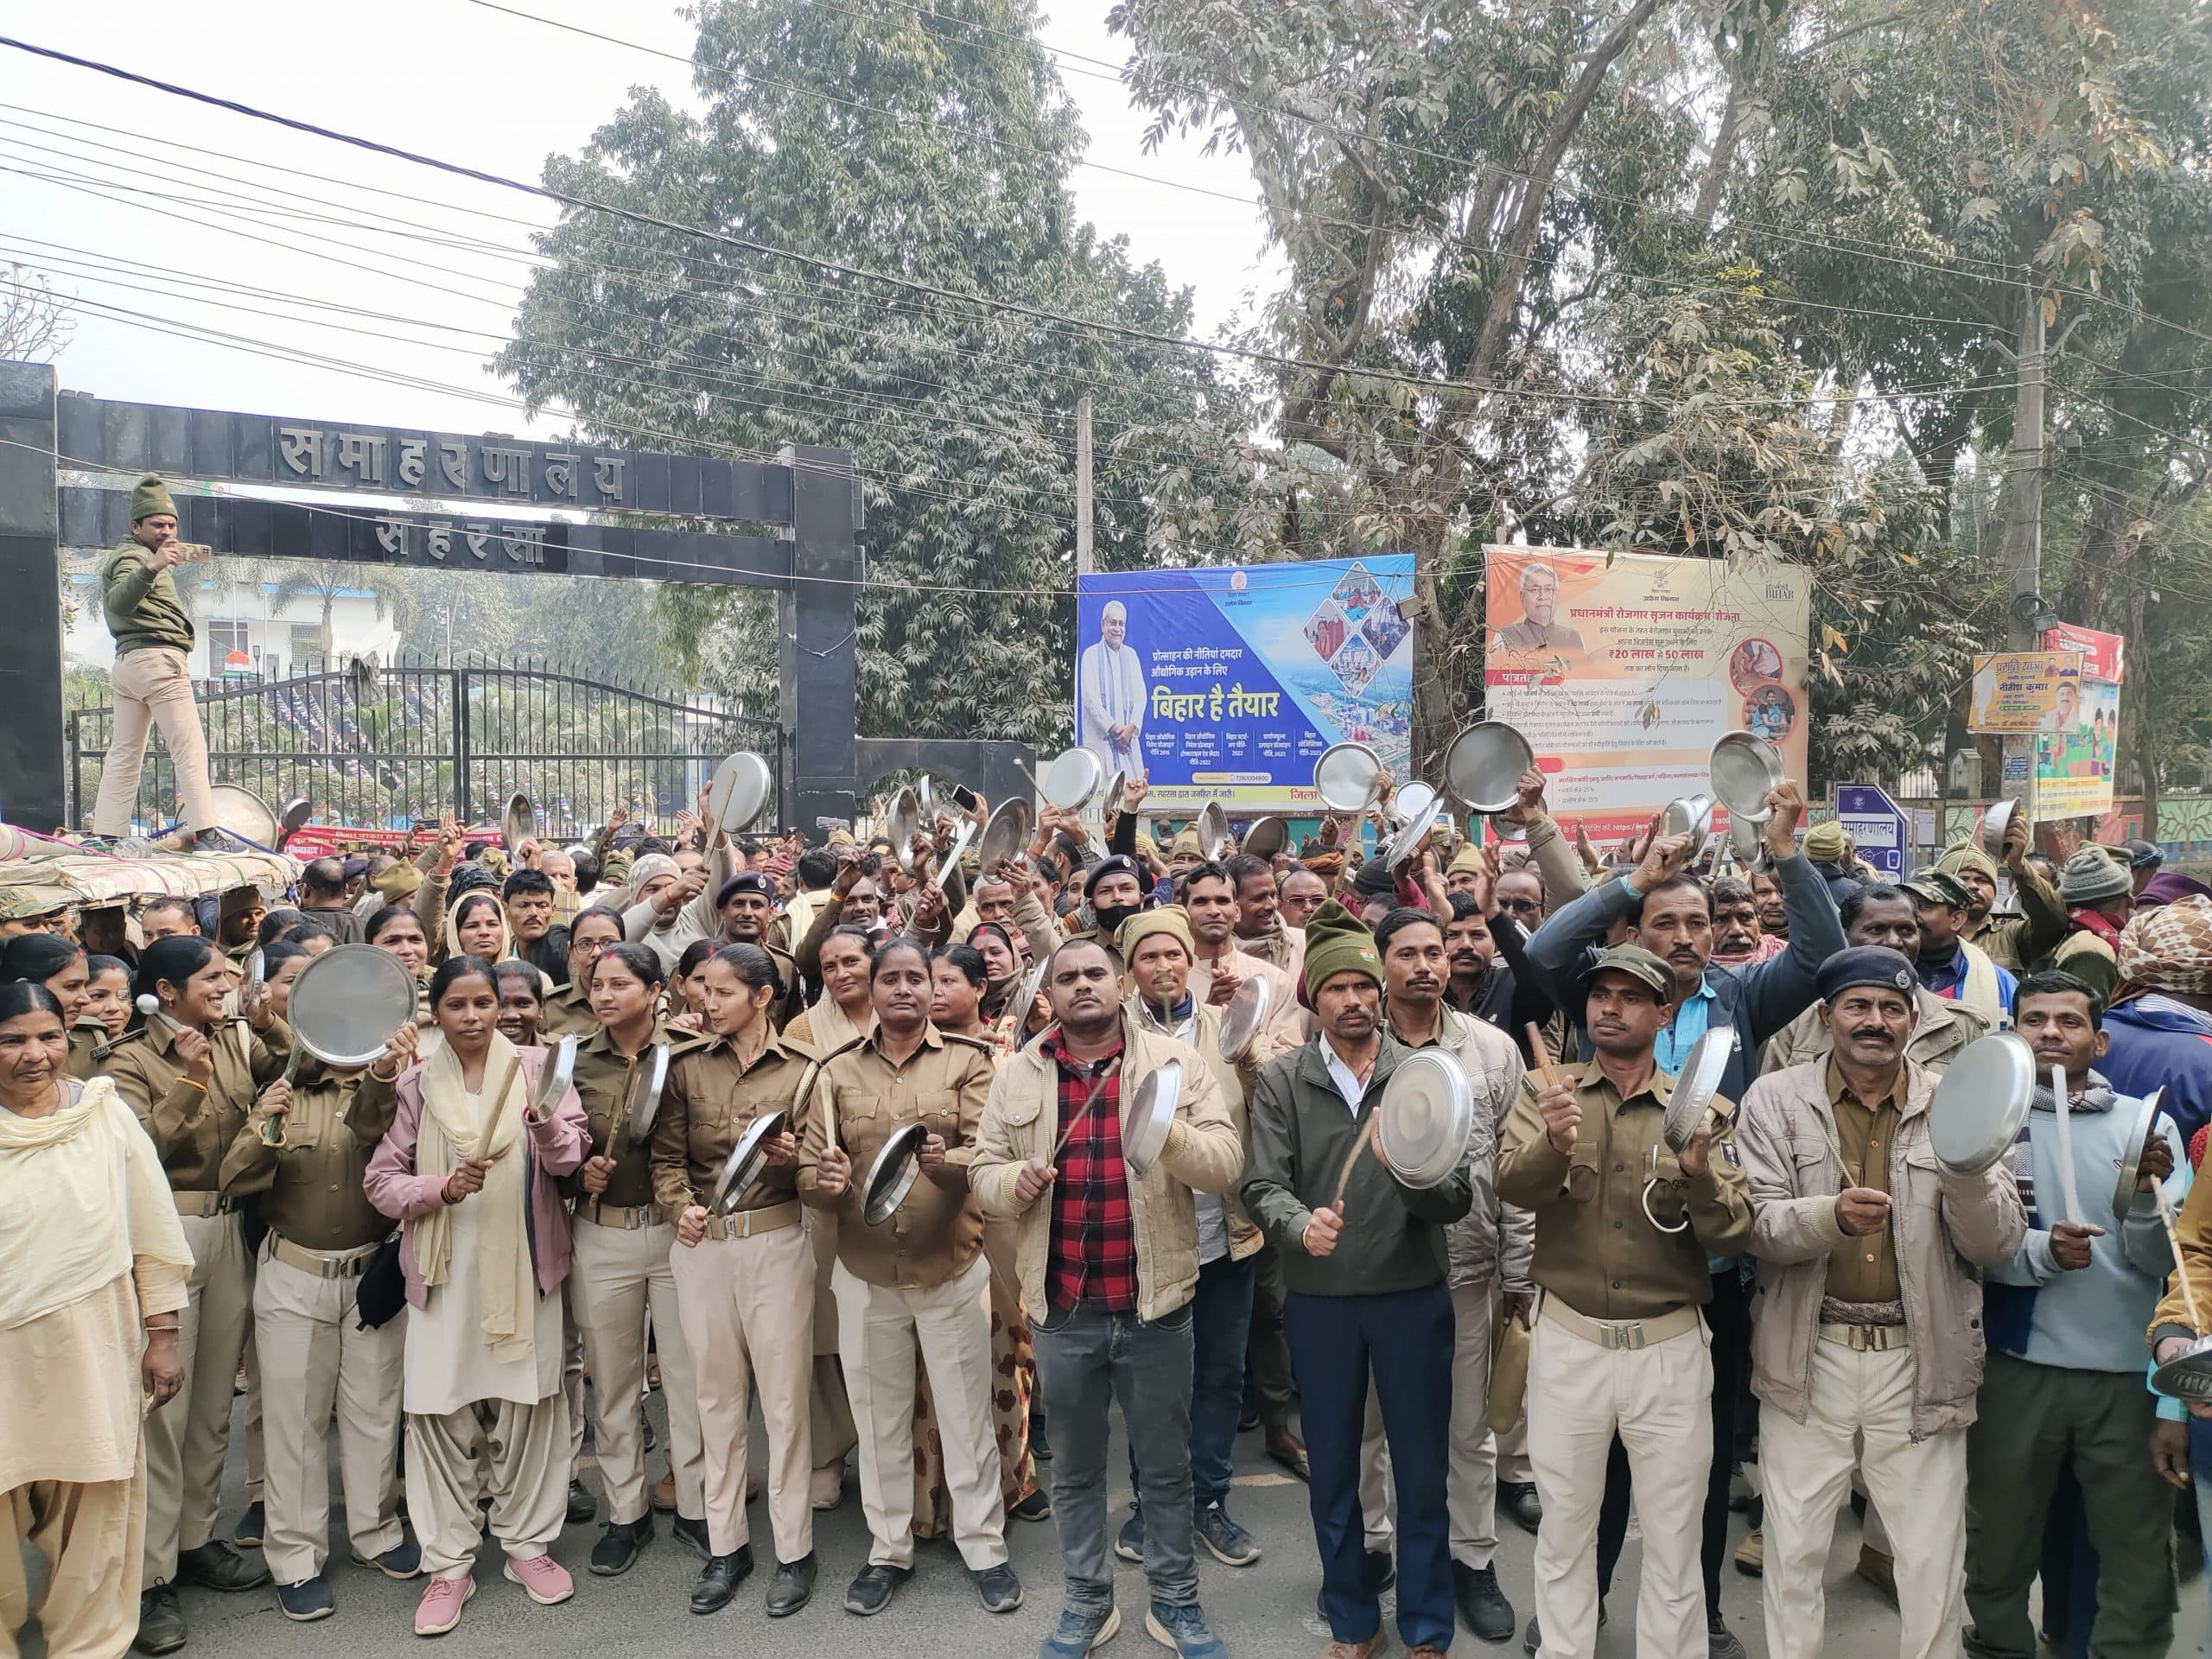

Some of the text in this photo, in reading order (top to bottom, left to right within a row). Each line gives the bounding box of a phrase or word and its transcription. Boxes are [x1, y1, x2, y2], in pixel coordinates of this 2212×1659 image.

[375, 516, 546, 564] सहरसा
[1569, 607, 1614, 619] प्रधानमंत्री
[1616, 607, 1648, 620] रोजगार
[1649, 611, 1673, 623] सृजन
[1675, 608, 1710, 621] कार्यक्रम
[1153, 647, 1243, 662] प्रोत्साहन की नीतियां दमदार
[1609, 650, 1628, 659] ₹20
[1630, 650, 1655, 659] लाख
[1665, 651, 1678, 659] 50
[1680, 650, 1704, 659] लाख
[1151, 663, 1228, 678] औद्योगिक उड़ान के लिए
[2025, 683, 2049, 693] कुमार
[1151, 682, 1280, 722] बिहार है तैयार
[1290, 788, 1318, 800] जिला
